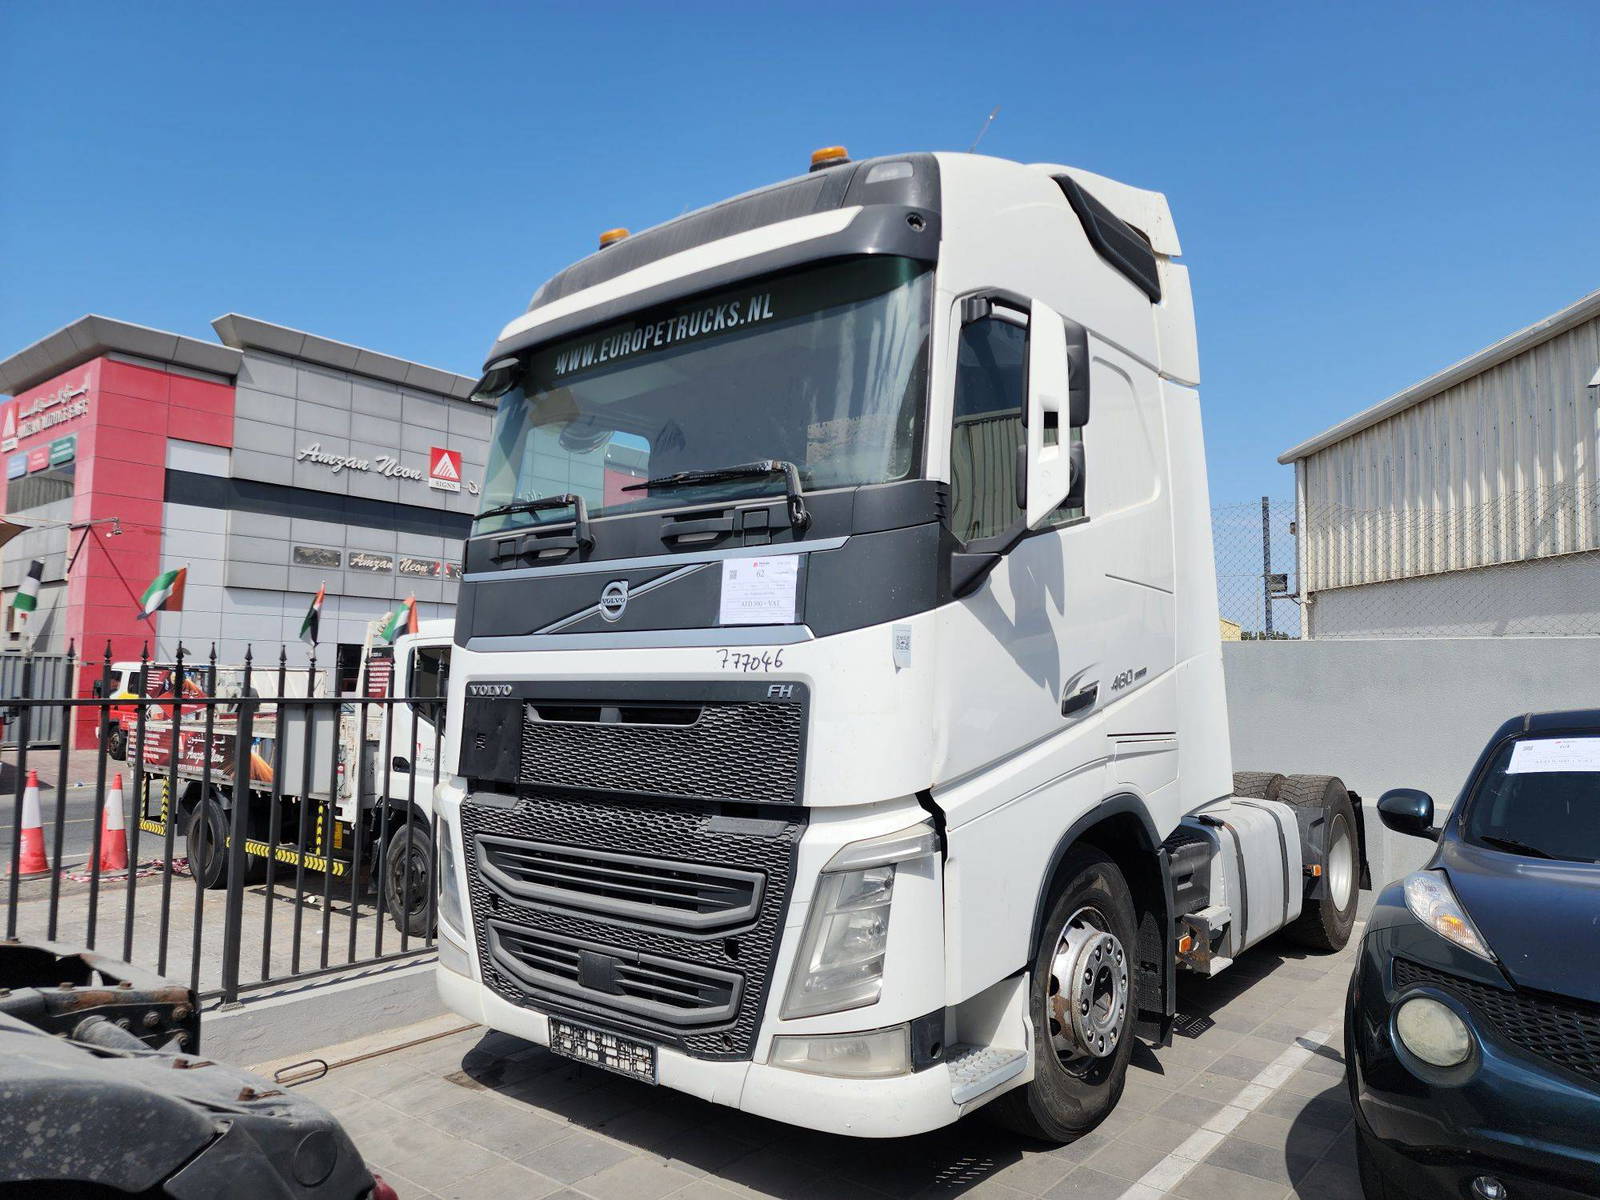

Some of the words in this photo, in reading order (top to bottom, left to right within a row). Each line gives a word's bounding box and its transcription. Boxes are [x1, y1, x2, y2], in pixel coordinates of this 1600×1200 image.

[555, 293, 774, 375] WWW.EUROPETRUCKS.NL
[297, 442, 369, 472] Amzan
[376, 456, 423, 480] Neon
[351, 553, 393, 571] Amzan
[399, 557, 428, 573] Neon
[717, 648, 783, 673] 777046
[470, 684, 513, 696] VOLVO
[767, 684, 794, 698] FH
[1111, 669, 1134, 691] 460
